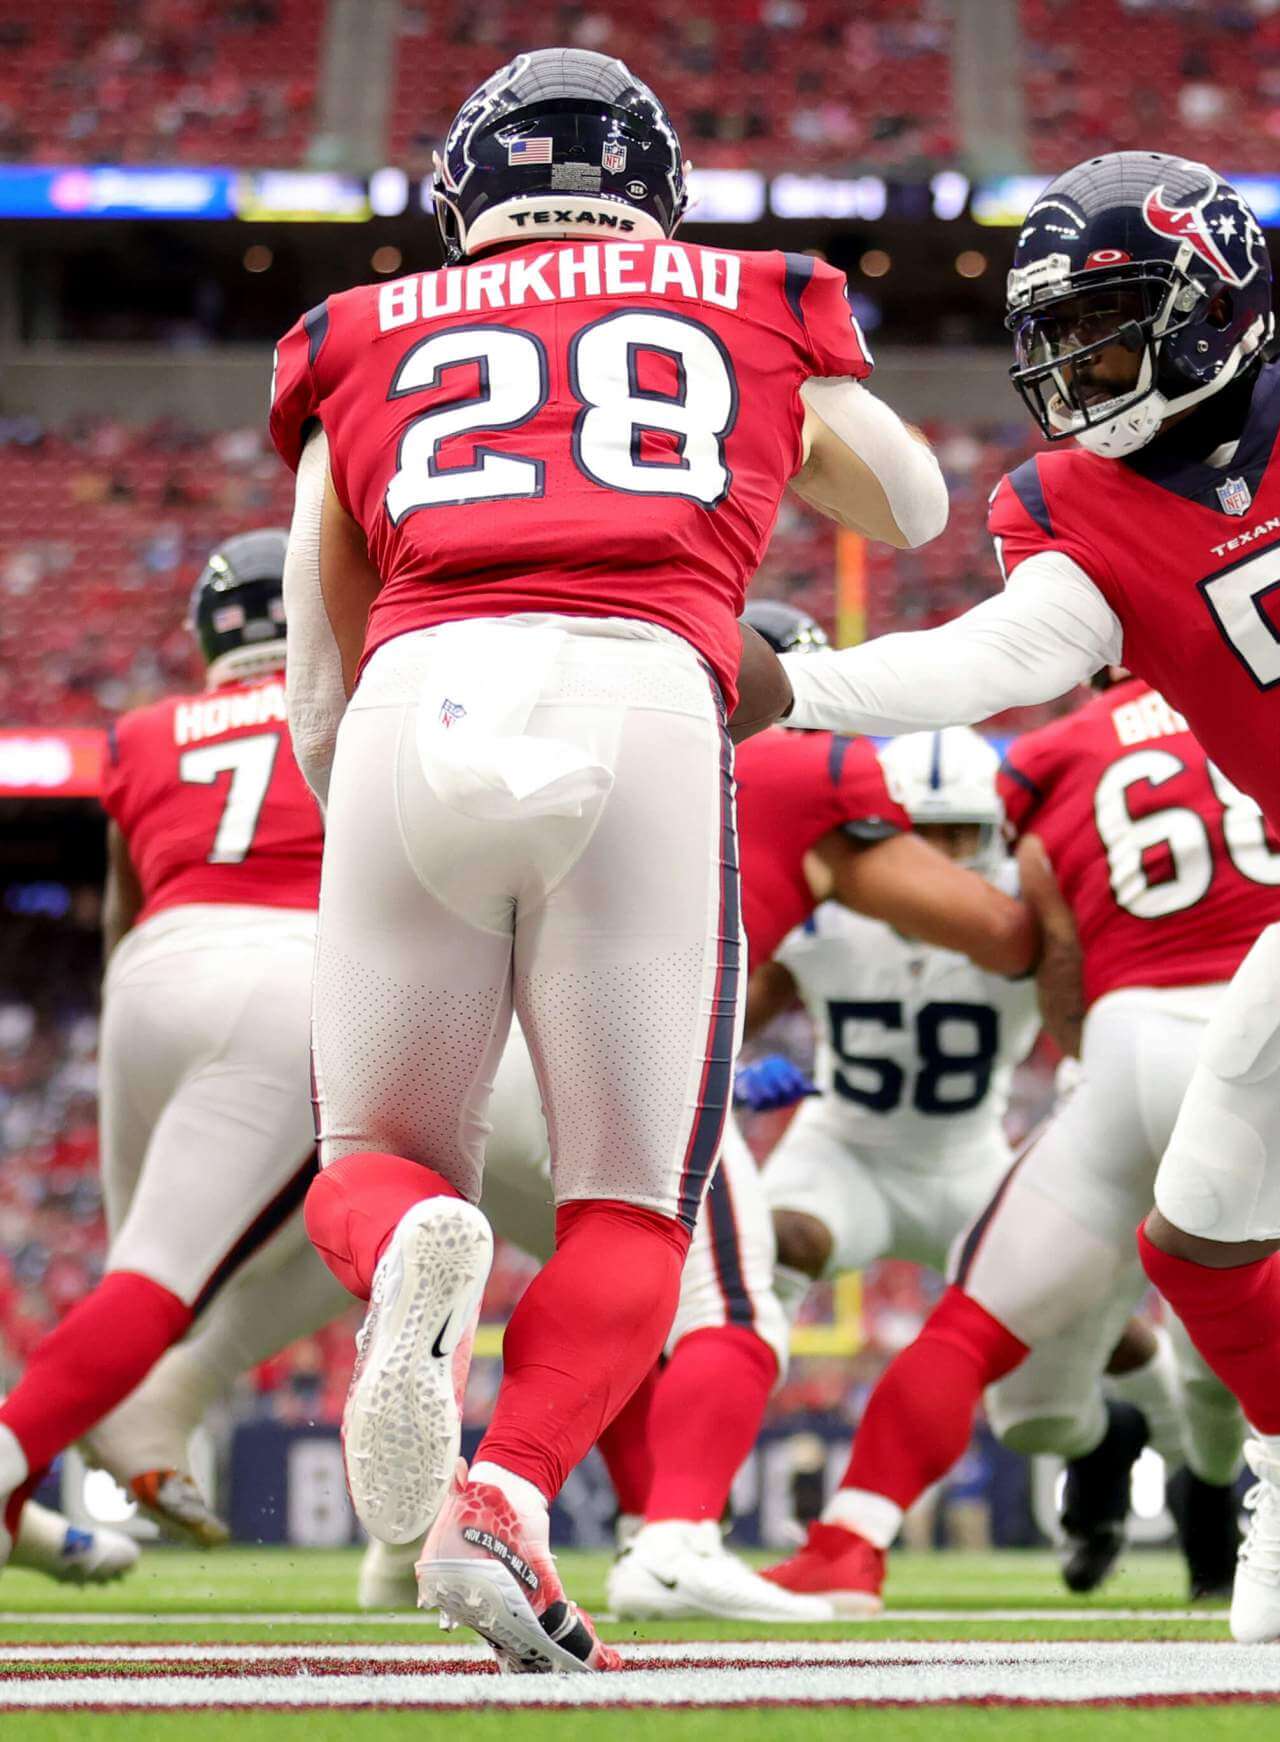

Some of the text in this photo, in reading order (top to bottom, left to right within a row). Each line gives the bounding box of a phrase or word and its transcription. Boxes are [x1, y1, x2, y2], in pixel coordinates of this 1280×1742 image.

[508, 210, 637, 232] TEXANS
[378, 243, 740, 332] BURKHEAD
[385, 306, 740, 529] 28
[179, 732, 280, 865] 7
[827, 1000, 1000, 1116] 58
